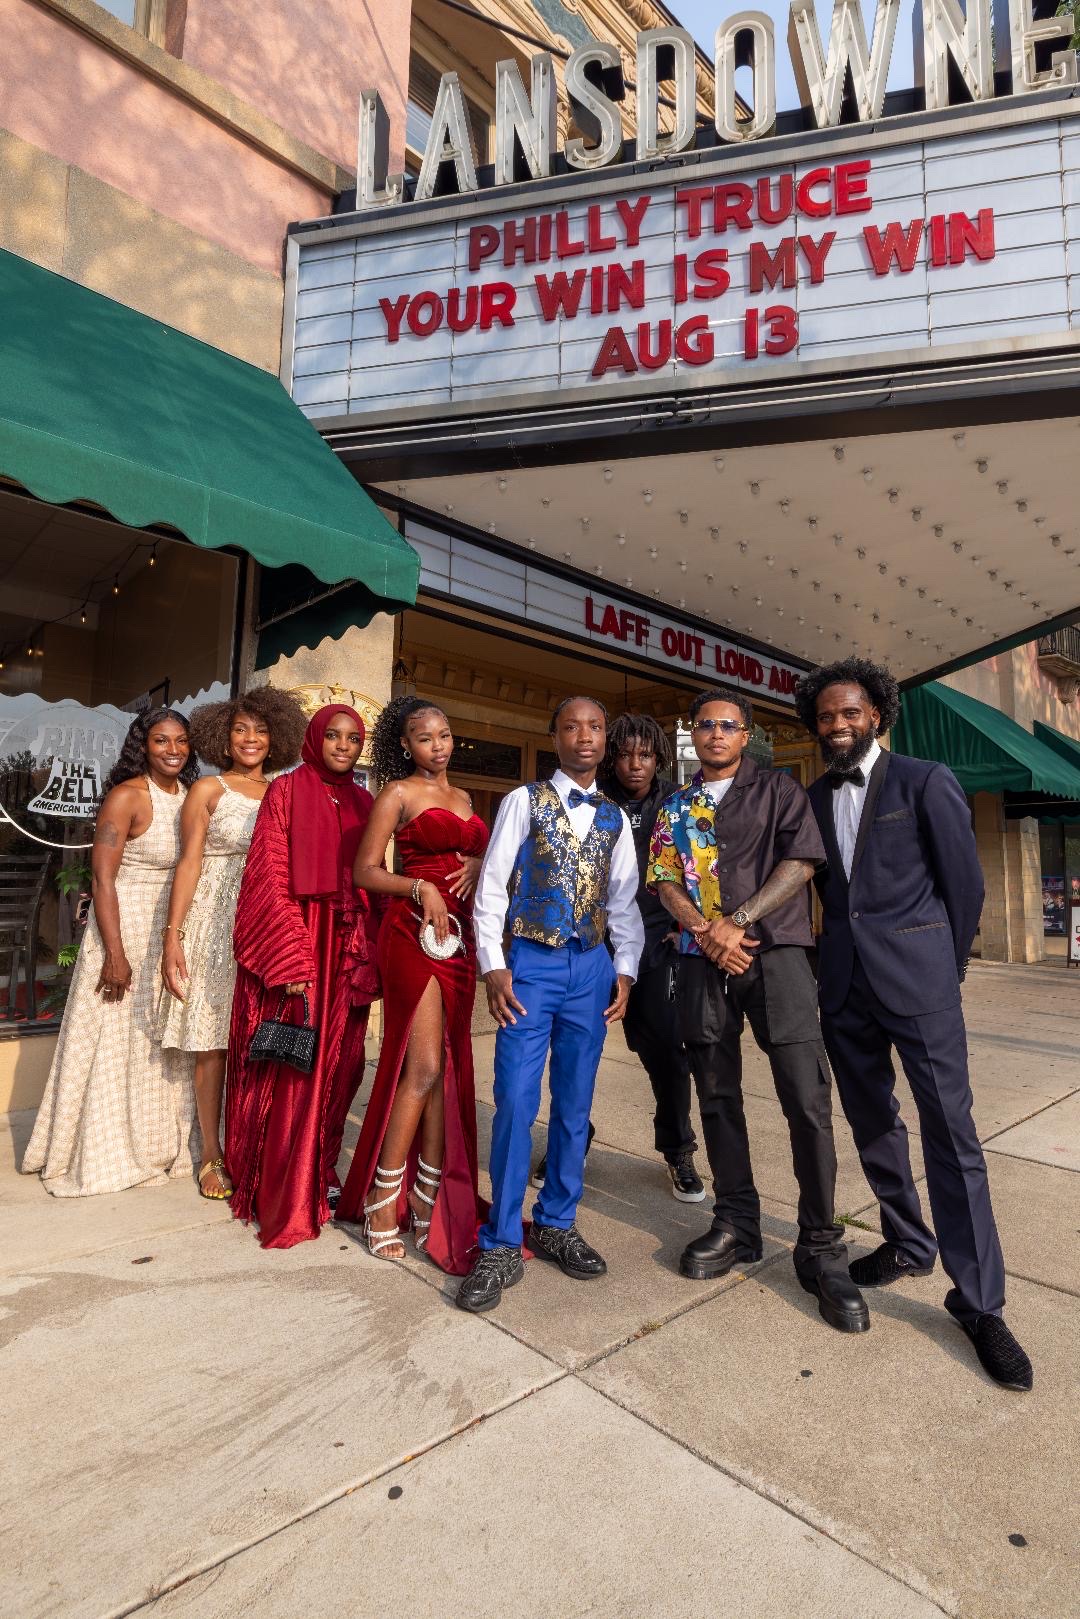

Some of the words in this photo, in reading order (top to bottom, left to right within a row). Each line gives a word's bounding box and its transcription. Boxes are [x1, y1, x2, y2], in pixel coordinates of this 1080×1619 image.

[356, 0, 1078, 210] LANSDOWNE
[468, 195, 652, 271] PHILLY
[676, 159, 873, 238] TRUCE
[378, 281, 517, 342] YOUR
[534, 259, 645, 322] WIN
[673, 248, 730, 303] IS
[749, 231, 837, 293] MY
[863, 207, 996, 275] WIN
[592, 314, 715, 377] AUG
[744, 304, 800, 360] 13
[584, 597, 650, 646] LAFF
[661, 627, 706, 667] OUT
[715, 644, 764, 685] LOUD
[39, 728, 117, 760] RING
[57, 757, 96, 779] THE
[33, 799, 80, 814] AMERICAN
